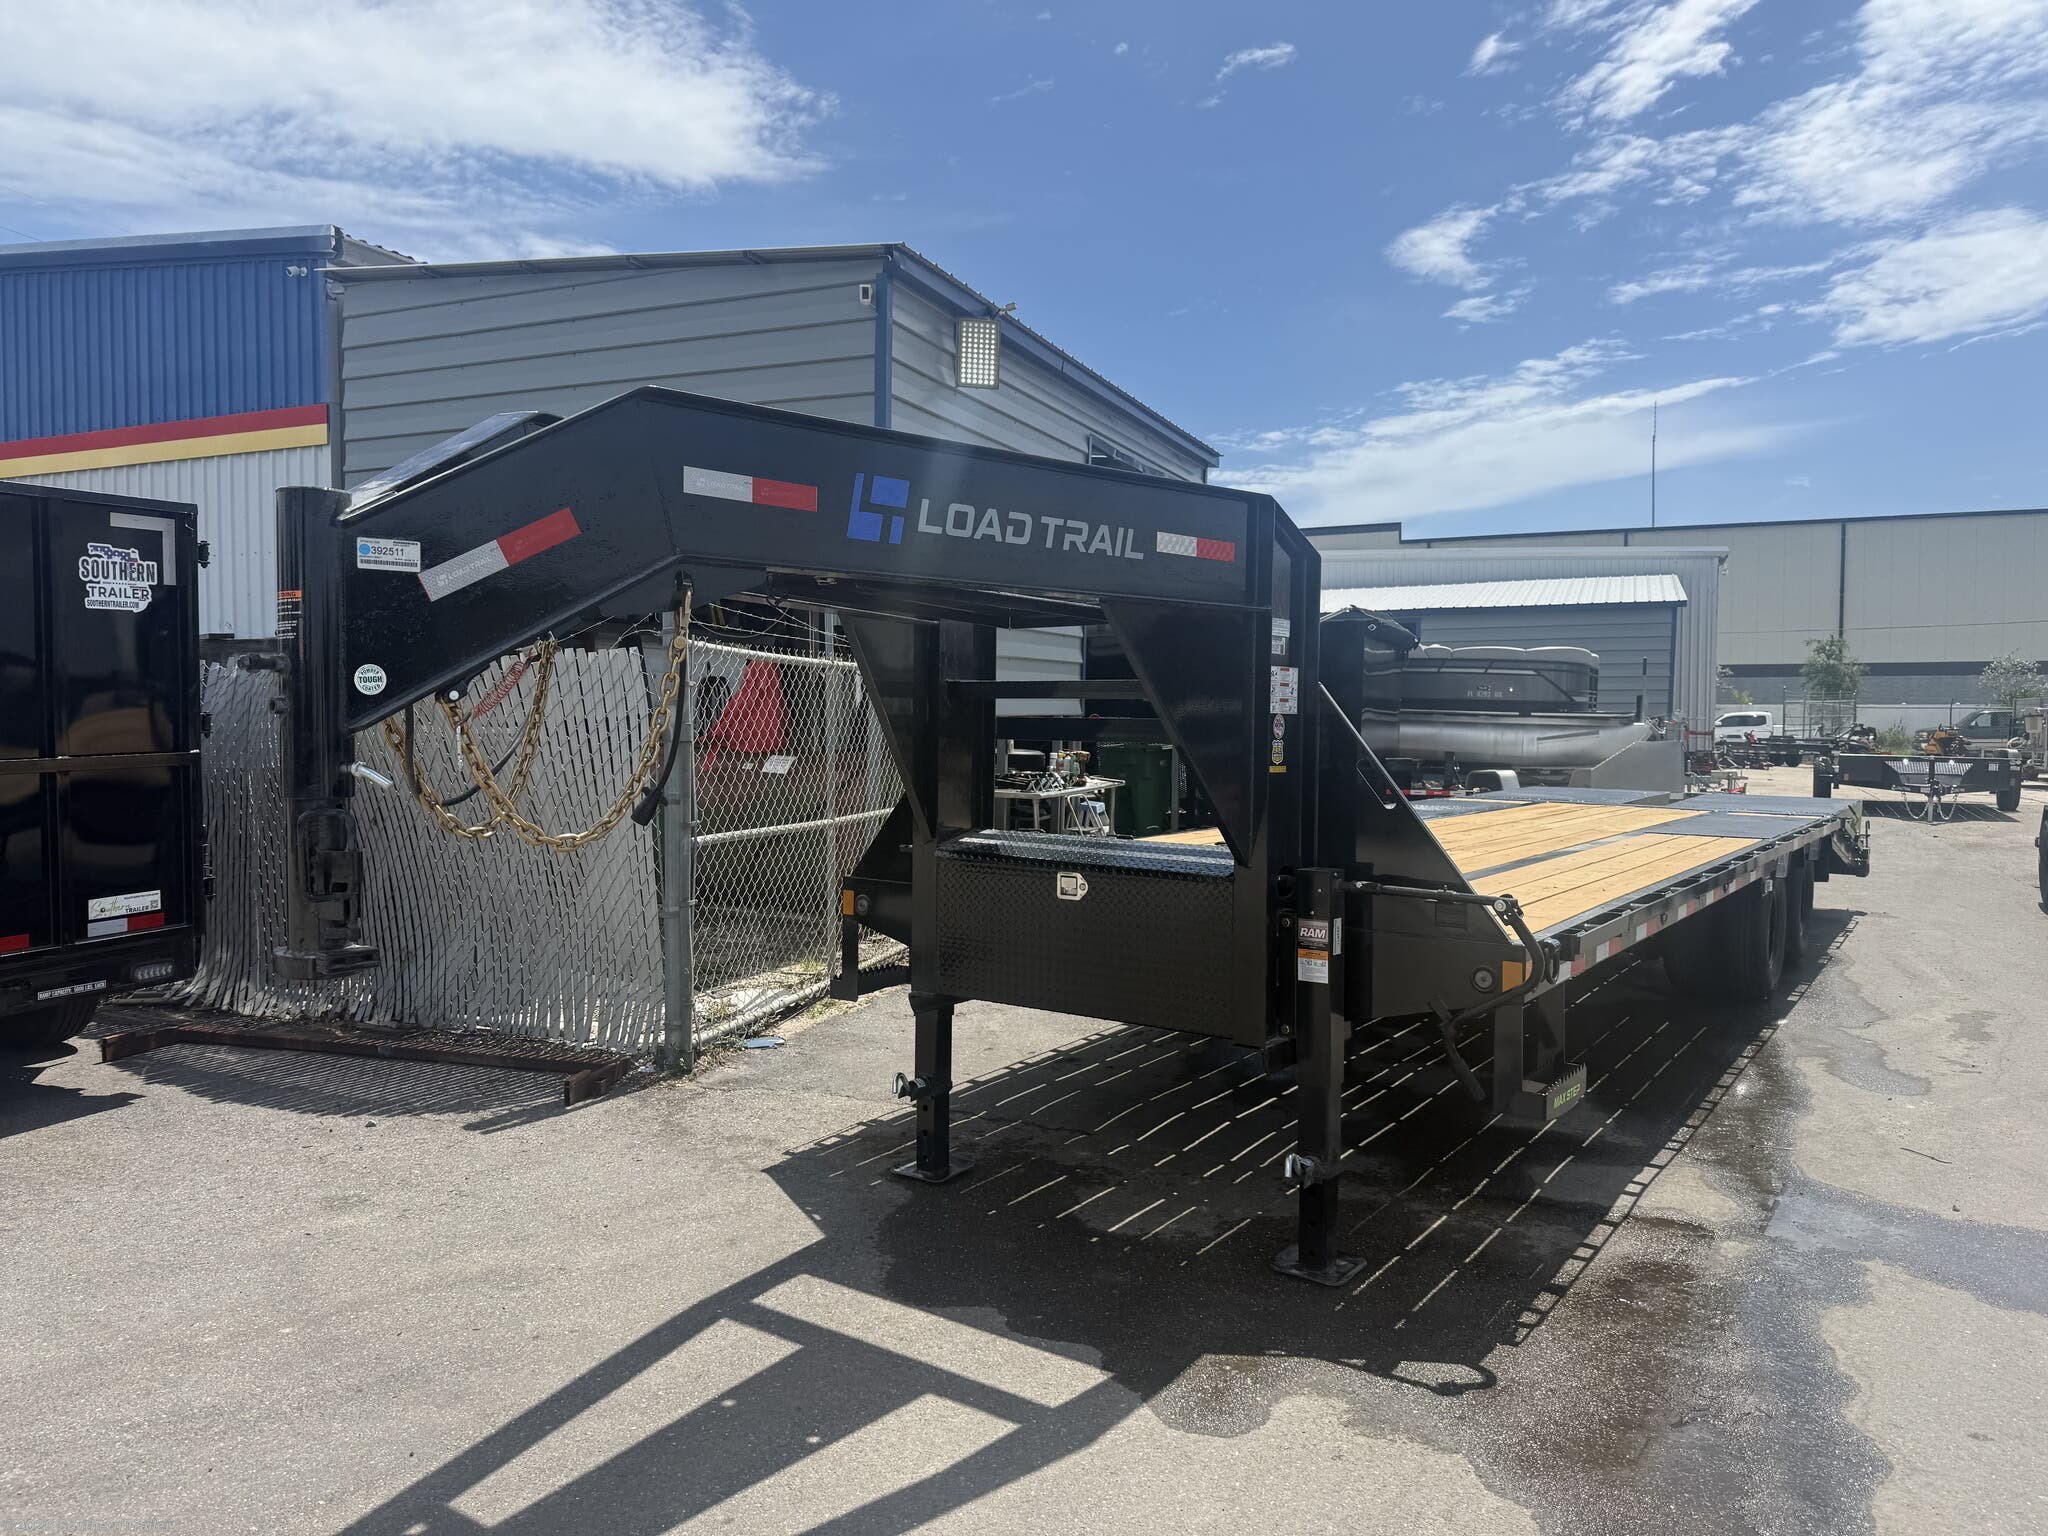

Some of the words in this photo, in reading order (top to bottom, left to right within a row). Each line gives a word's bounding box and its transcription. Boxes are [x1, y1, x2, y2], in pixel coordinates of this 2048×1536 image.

[917, 498, 1033, 545] LOAD
[1041, 516, 1144, 560] TRAIL
[371, 546, 404, 556] 392511
[81, 558, 155, 582] SOUTHERN
[88, 585, 150, 599] TRAILER
[87, 600, 140, 608] SOUTHERNTRAILER.COM
[358, 676, 383, 684] TOUGH
[1300, 928, 1326, 939] RAM
